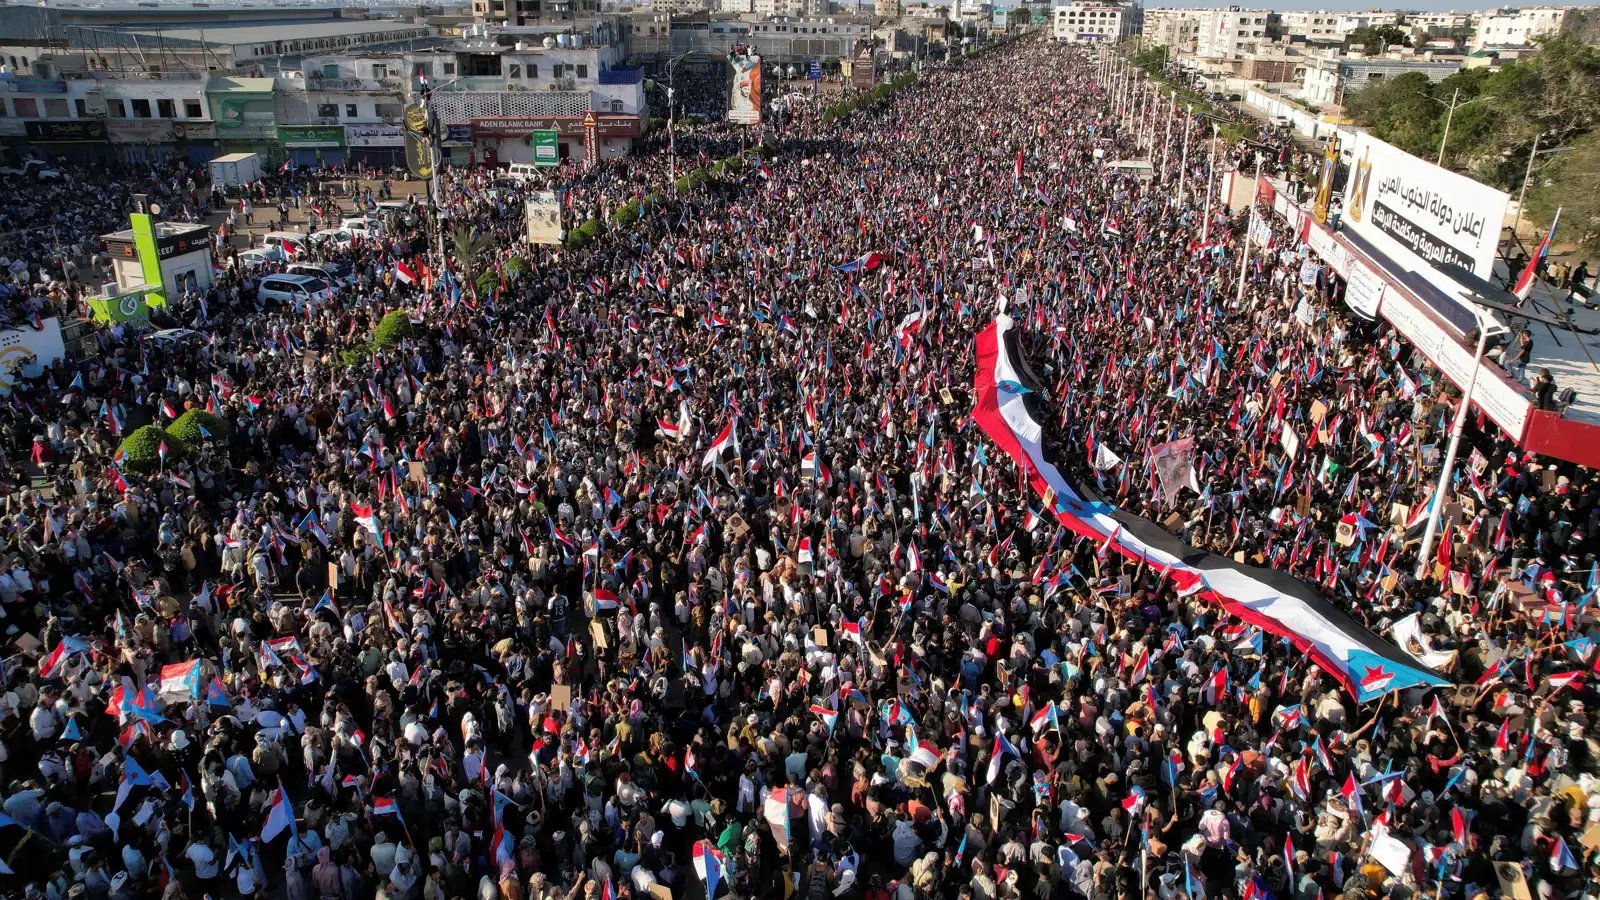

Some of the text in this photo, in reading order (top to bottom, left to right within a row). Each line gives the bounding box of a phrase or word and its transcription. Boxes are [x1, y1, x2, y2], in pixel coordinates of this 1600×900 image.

[353, 129, 379, 139] للتجارة
[479, 120, 544, 128] ADEN ISLAMIC BANK
[1372, 206, 1394, 231] الإرهاب
[1378, 176, 1486, 249] إعلان دولة الجنوب العربي
[1391, 214, 1420, 251] ومكافحة
[1419, 232, 1446, 263] العروبة
[555, 605, 564, 616] 13
